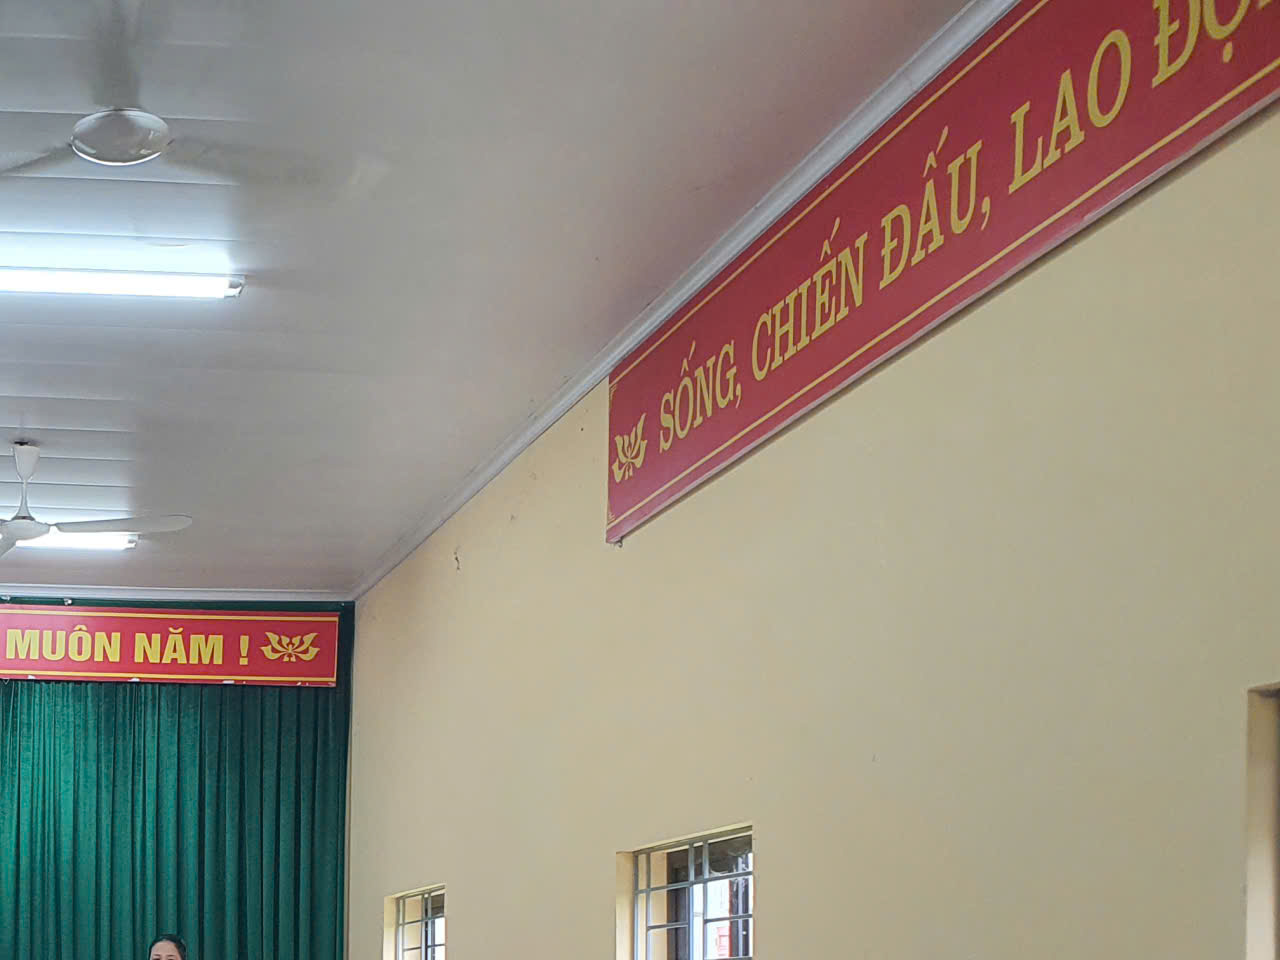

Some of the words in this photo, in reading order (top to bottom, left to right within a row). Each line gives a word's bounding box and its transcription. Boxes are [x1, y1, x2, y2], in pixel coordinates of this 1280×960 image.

[659, 341, 743, 454] SỐNG,
[751, 217, 868, 382] CHIẾN
[879, 126, 991, 291] ĐẤU,
[1008, 29, 1132, 195] LAO
[6, 624, 121, 662] MUÔN
[134, 627, 224, 664] NĂM
